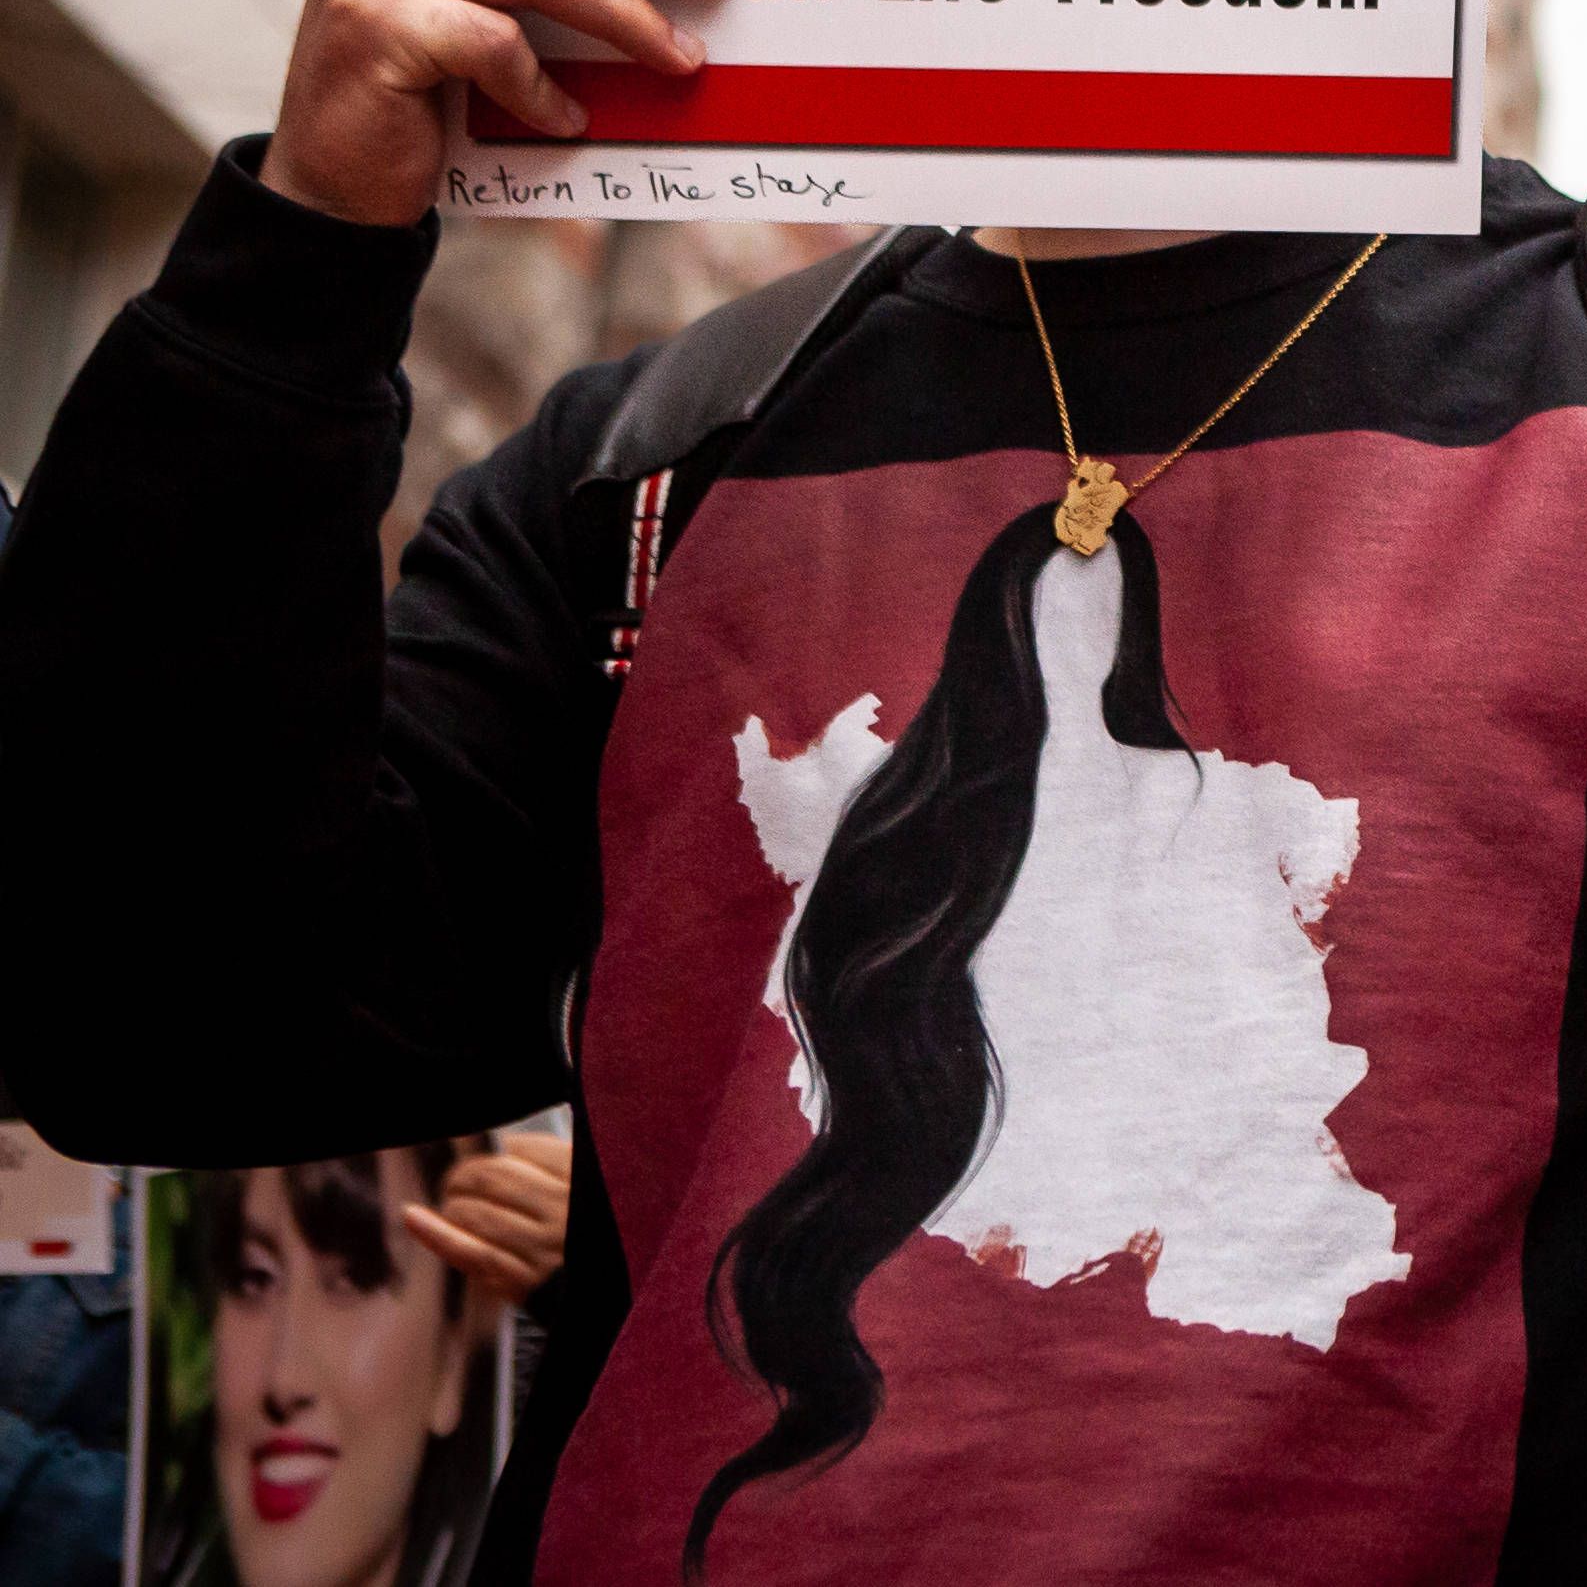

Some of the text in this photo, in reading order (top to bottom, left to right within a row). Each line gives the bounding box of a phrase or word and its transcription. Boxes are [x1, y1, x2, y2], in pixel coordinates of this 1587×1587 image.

[447, 165, 575, 206] Return
[593, 172, 632, 201] To
[642, 164, 715, 204] The
